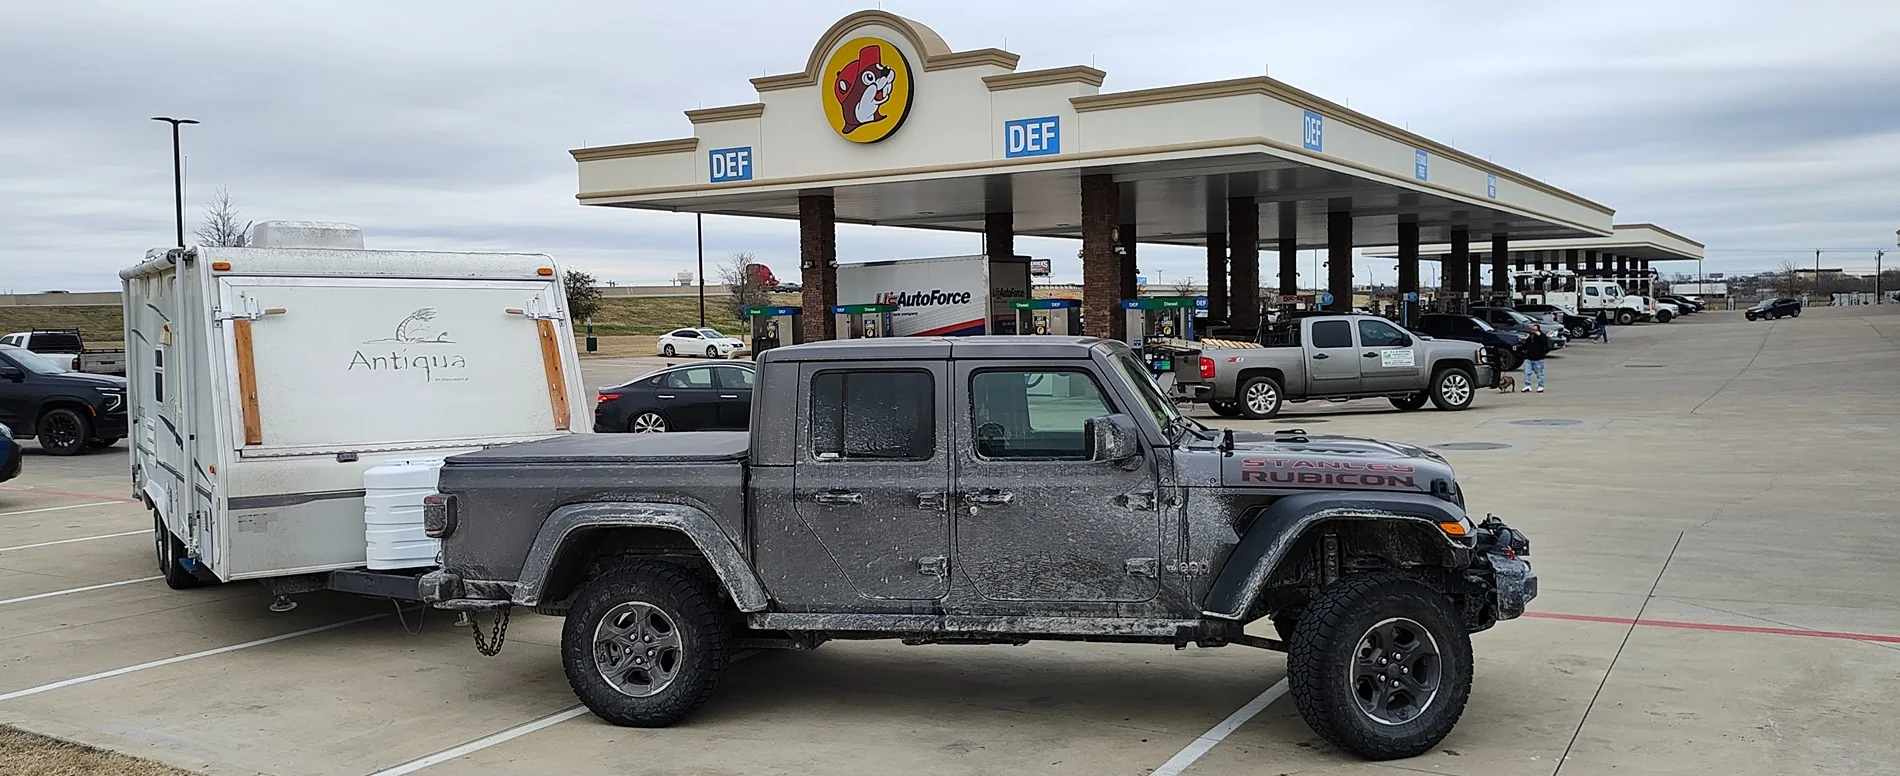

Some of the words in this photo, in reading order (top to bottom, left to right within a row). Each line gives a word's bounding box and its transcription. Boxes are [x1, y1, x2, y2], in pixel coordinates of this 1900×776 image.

[1009, 121, 1055, 153] DEF
[1305, 116, 1321, 146] DEF
[712, 151, 748, 179] DEF
[1195, 299, 1207, 307] DEF
[1241, 458, 1416, 473] STANLEY
[1241, 470, 1415, 487] RUBICON
